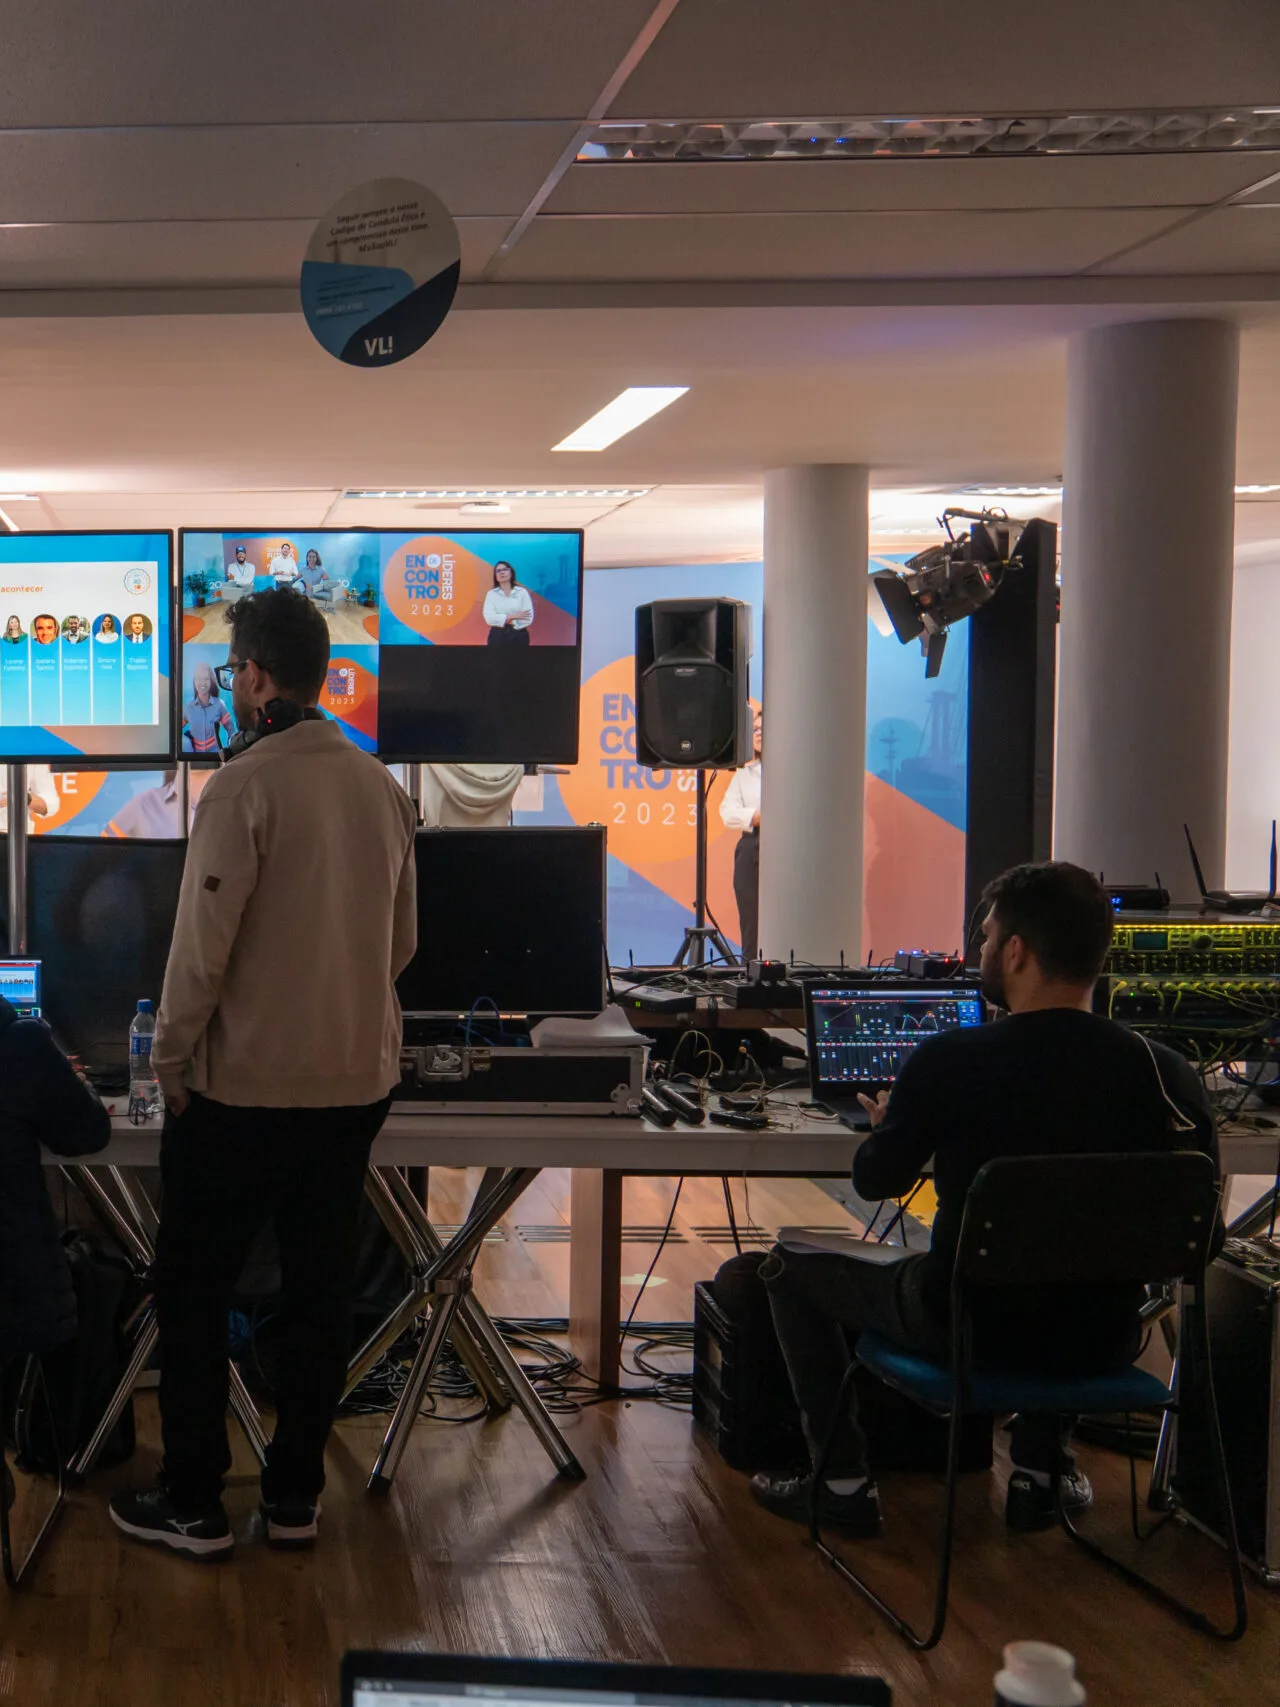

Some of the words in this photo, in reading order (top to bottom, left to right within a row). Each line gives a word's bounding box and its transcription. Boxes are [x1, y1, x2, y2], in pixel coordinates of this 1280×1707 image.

[336, 213, 360, 223] Seguir
[369, 215, 400, 228] Conduta
[406, 554, 425, 569] EN
[404, 569, 440, 584] CON
[442, 553, 456, 601] LÍDERES
[0, 585, 43, 594] acontecer
[404, 584, 440, 600] TRO
[410, 603, 454, 616] 2023
[599, 725, 636, 755] CO
[599, 758, 672, 791] TRO
[612, 801, 697, 826] 2023
